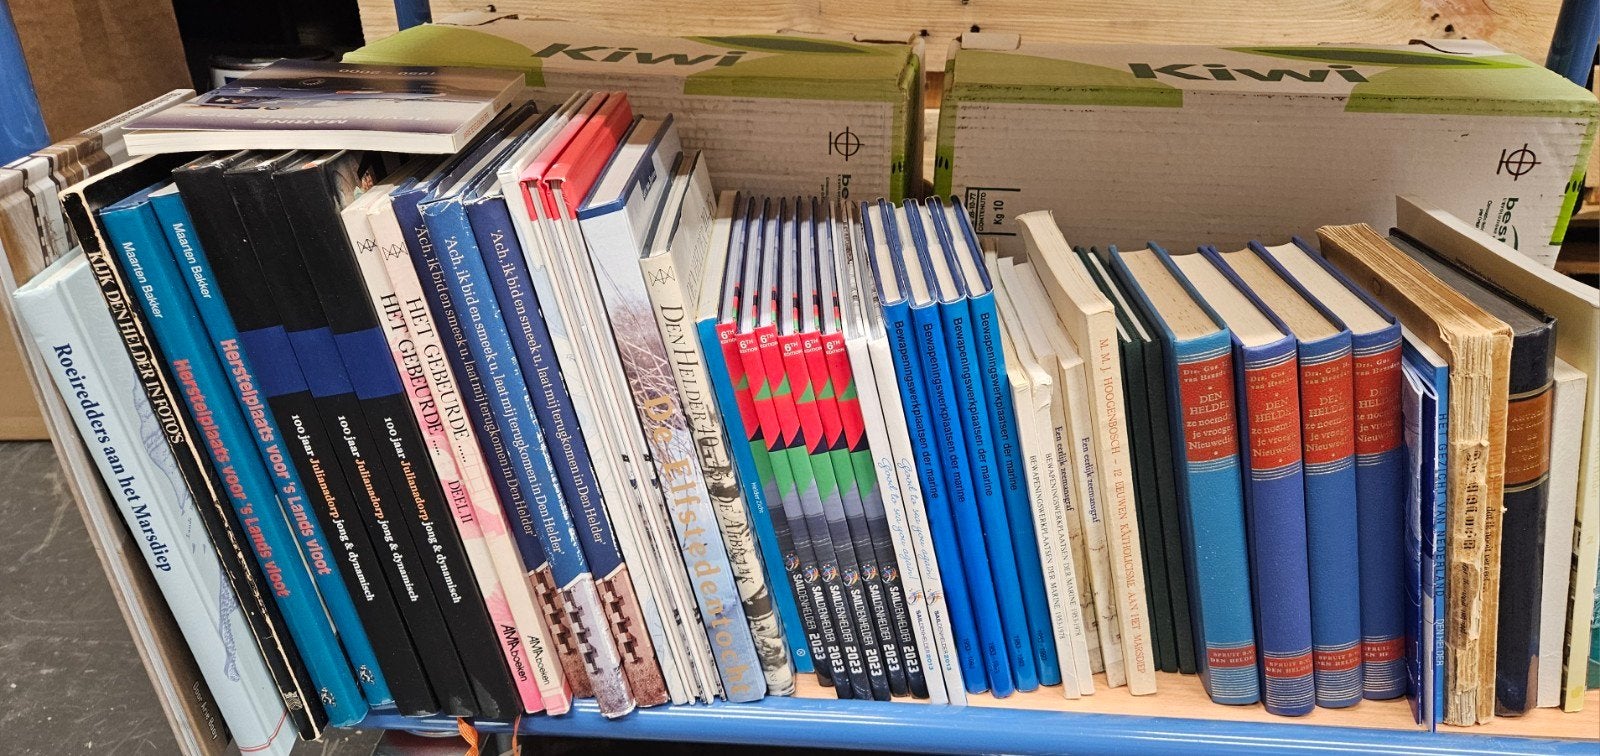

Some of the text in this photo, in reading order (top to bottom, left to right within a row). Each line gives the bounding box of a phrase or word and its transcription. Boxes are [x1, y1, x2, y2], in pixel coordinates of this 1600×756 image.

[531, 43, 748, 67] Kiwi
[1128, 63, 1370, 83] Kiwi
[978, 192, 987, 232] CONTENUTO
[993, 200, 1005, 225] Kg 10
[122, 242, 162, 317] Maarten Bakker
[173, 223, 211, 297] Maarten Bakker
[461, 282, 478, 305] bid
[506, 276, 523, 298] bid
[513, 299, 525, 314] en
[88, 251, 186, 443] KIJK DEN HELDER IN FOTO'S
[474, 323, 496, 361] smeek
[519, 315, 541, 353] smeek
[721, 330, 734, 340] 6TH
[740, 339, 754, 348] 6TH
[761, 333, 774, 343] 6TH
[784, 342, 798, 352] 6TH
[805, 339, 818, 348] 6TH
[826, 340, 840, 350] 6TH
[1099, 338, 1108, 350] M.
[380, 292, 442, 434] HET GEBEURDE
[406, 297, 468, 439] HET GEBEURDE
[537, 366, 552, 388] laat
[660, 305, 685, 343] DEN
[673, 349, 713, 423] HELDER
[1100, 352, 1110, 364] M.
[492, 374, 508, 396] laat
[544, 389, 560, 408] mij
[980, 312, 1017, 490] Bewapeningswerkplaatsen marine
[1200, 391, 1222, 404] DEN
[1266, 397, 1288, 411] DEN
[500, 397, 517, 416] mij
[894, 321, 940, 498] Bewapeningswerkplaatsen marine
[923, 323, 967, 502] Bewapeningswerkplaatsen marine
[953, 317, 992, 495] Bewapeningswerkplaatsen marine
[1103, 377, 1120, 453] HOOGENBOSCH
[508, 417, 536, 482] terugkomen
[551, 408, 578, 473] terugkomen
[1081, 436, 1089, 452] Een
[1193, 430, 1201, 439] je
[54, 344, 170, 571] Roeiredders aan het Marsdiep
[221, 339, 273, 440] Herstelplaats
[267, 444, 290, 478] voor
[285, 496, 313, 535] Lands
[306, 539, 331, 574] vloot
[170, 359, 228, 463] Herstelplaats
[218, 465, 246, 501] voor
[241, 516, 275, 559] Lands
[261, 560, 290, 598] vloot
[531, 483, 541, 495] in
[573, 473, 583, 485] in
[577, 485, 590, 507] Den
[291, 414, 374, 600] 100 jaar Julianadorp jong dynamisch
[337, 415, 418, 601] 100 jaar Julianadorp jong dynamisch
[384, 417, 461, 603] 100 jaar Julianadorp jong dynamisch
[448, 480, 473, 523] DEEL II
[535, 494, 548, 516] Den
[1435, 411, 1448, 598] HET GEZICHT VAN NEDERLAND
[642, 399, 751, 689] De Elfstedentocht
[792, 572, 827, 661] SAILDENHELDER 2023
[810, 584, 846, 673] SAILDENHELDER 2023
[828, 585, 862, 673] SAILDENHELDER 2023
[849, 589, 881, 675] SAILDENHELDER 2023
[866, 584, 899, 672] SAILDENHELDER 2023
[889, 584, 918, 672] SAILDENHELDER 2023
[1134, 634, 1145, 673] MARSDIEP
